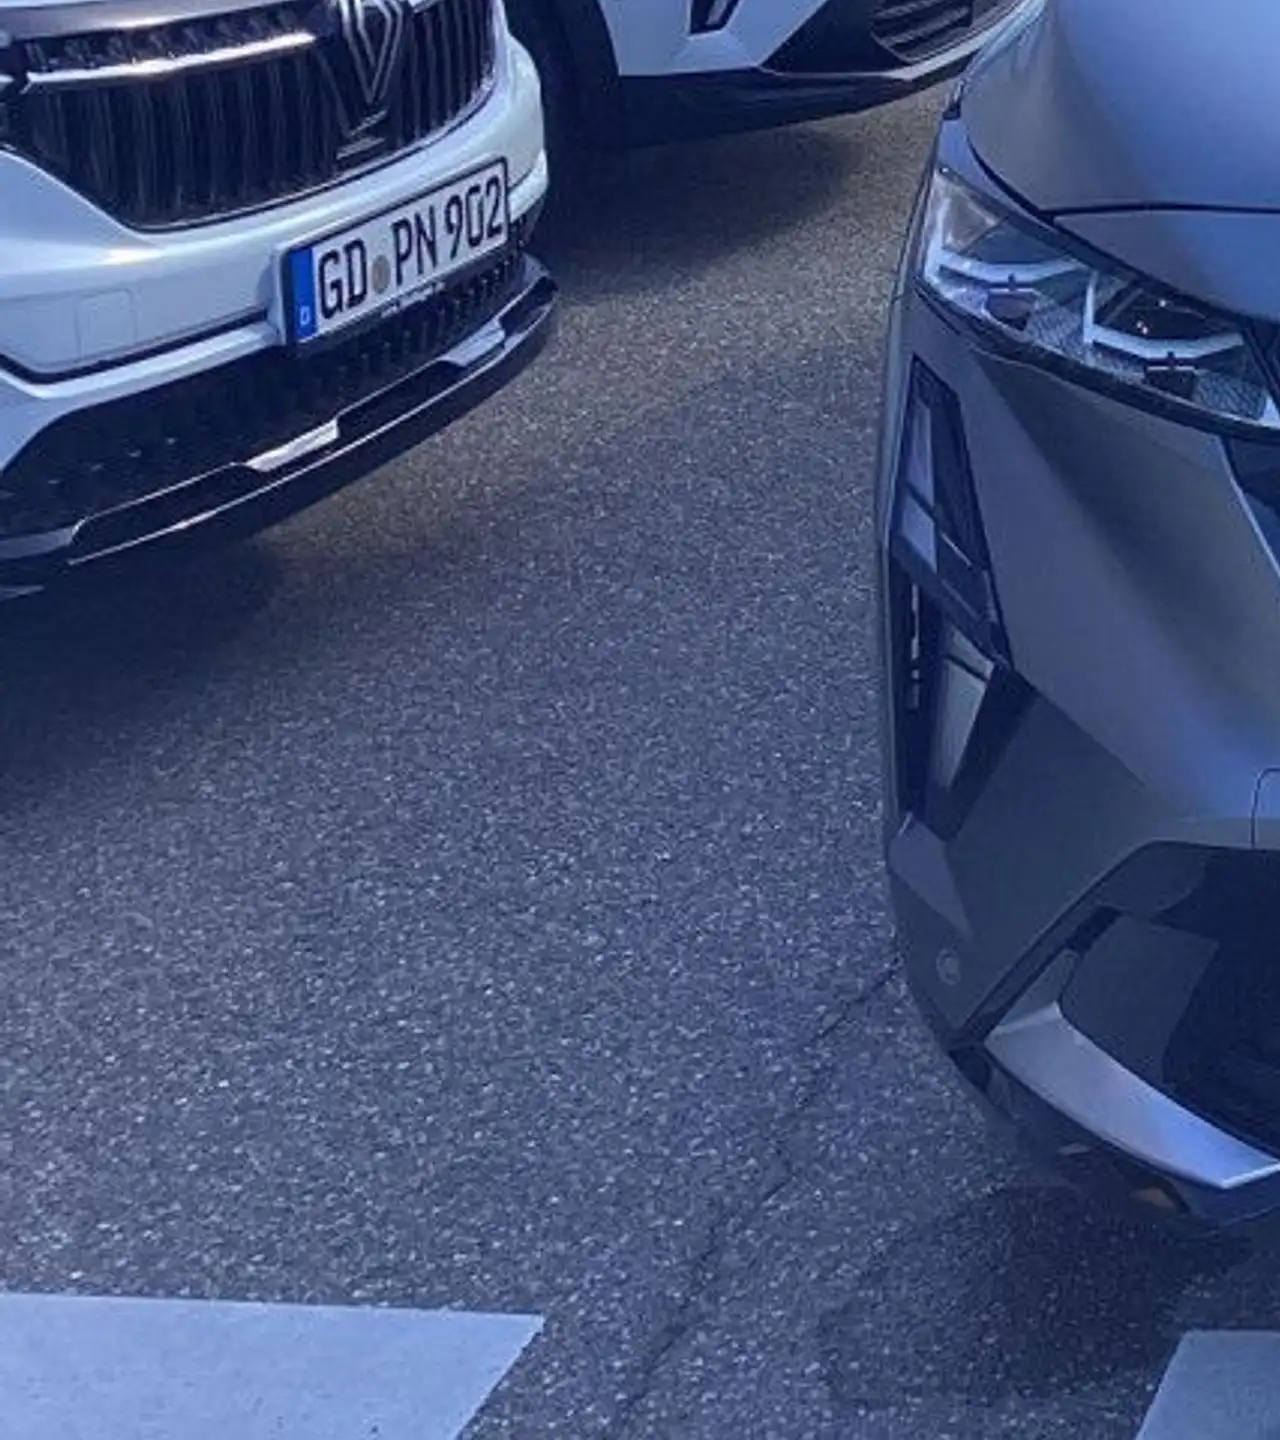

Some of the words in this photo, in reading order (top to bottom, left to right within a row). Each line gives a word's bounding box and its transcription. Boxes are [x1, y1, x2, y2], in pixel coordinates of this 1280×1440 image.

[318, 238, 368, 320] GD
[391, 206, 438, 286] PN
[445, 175, 502, 260] 902
